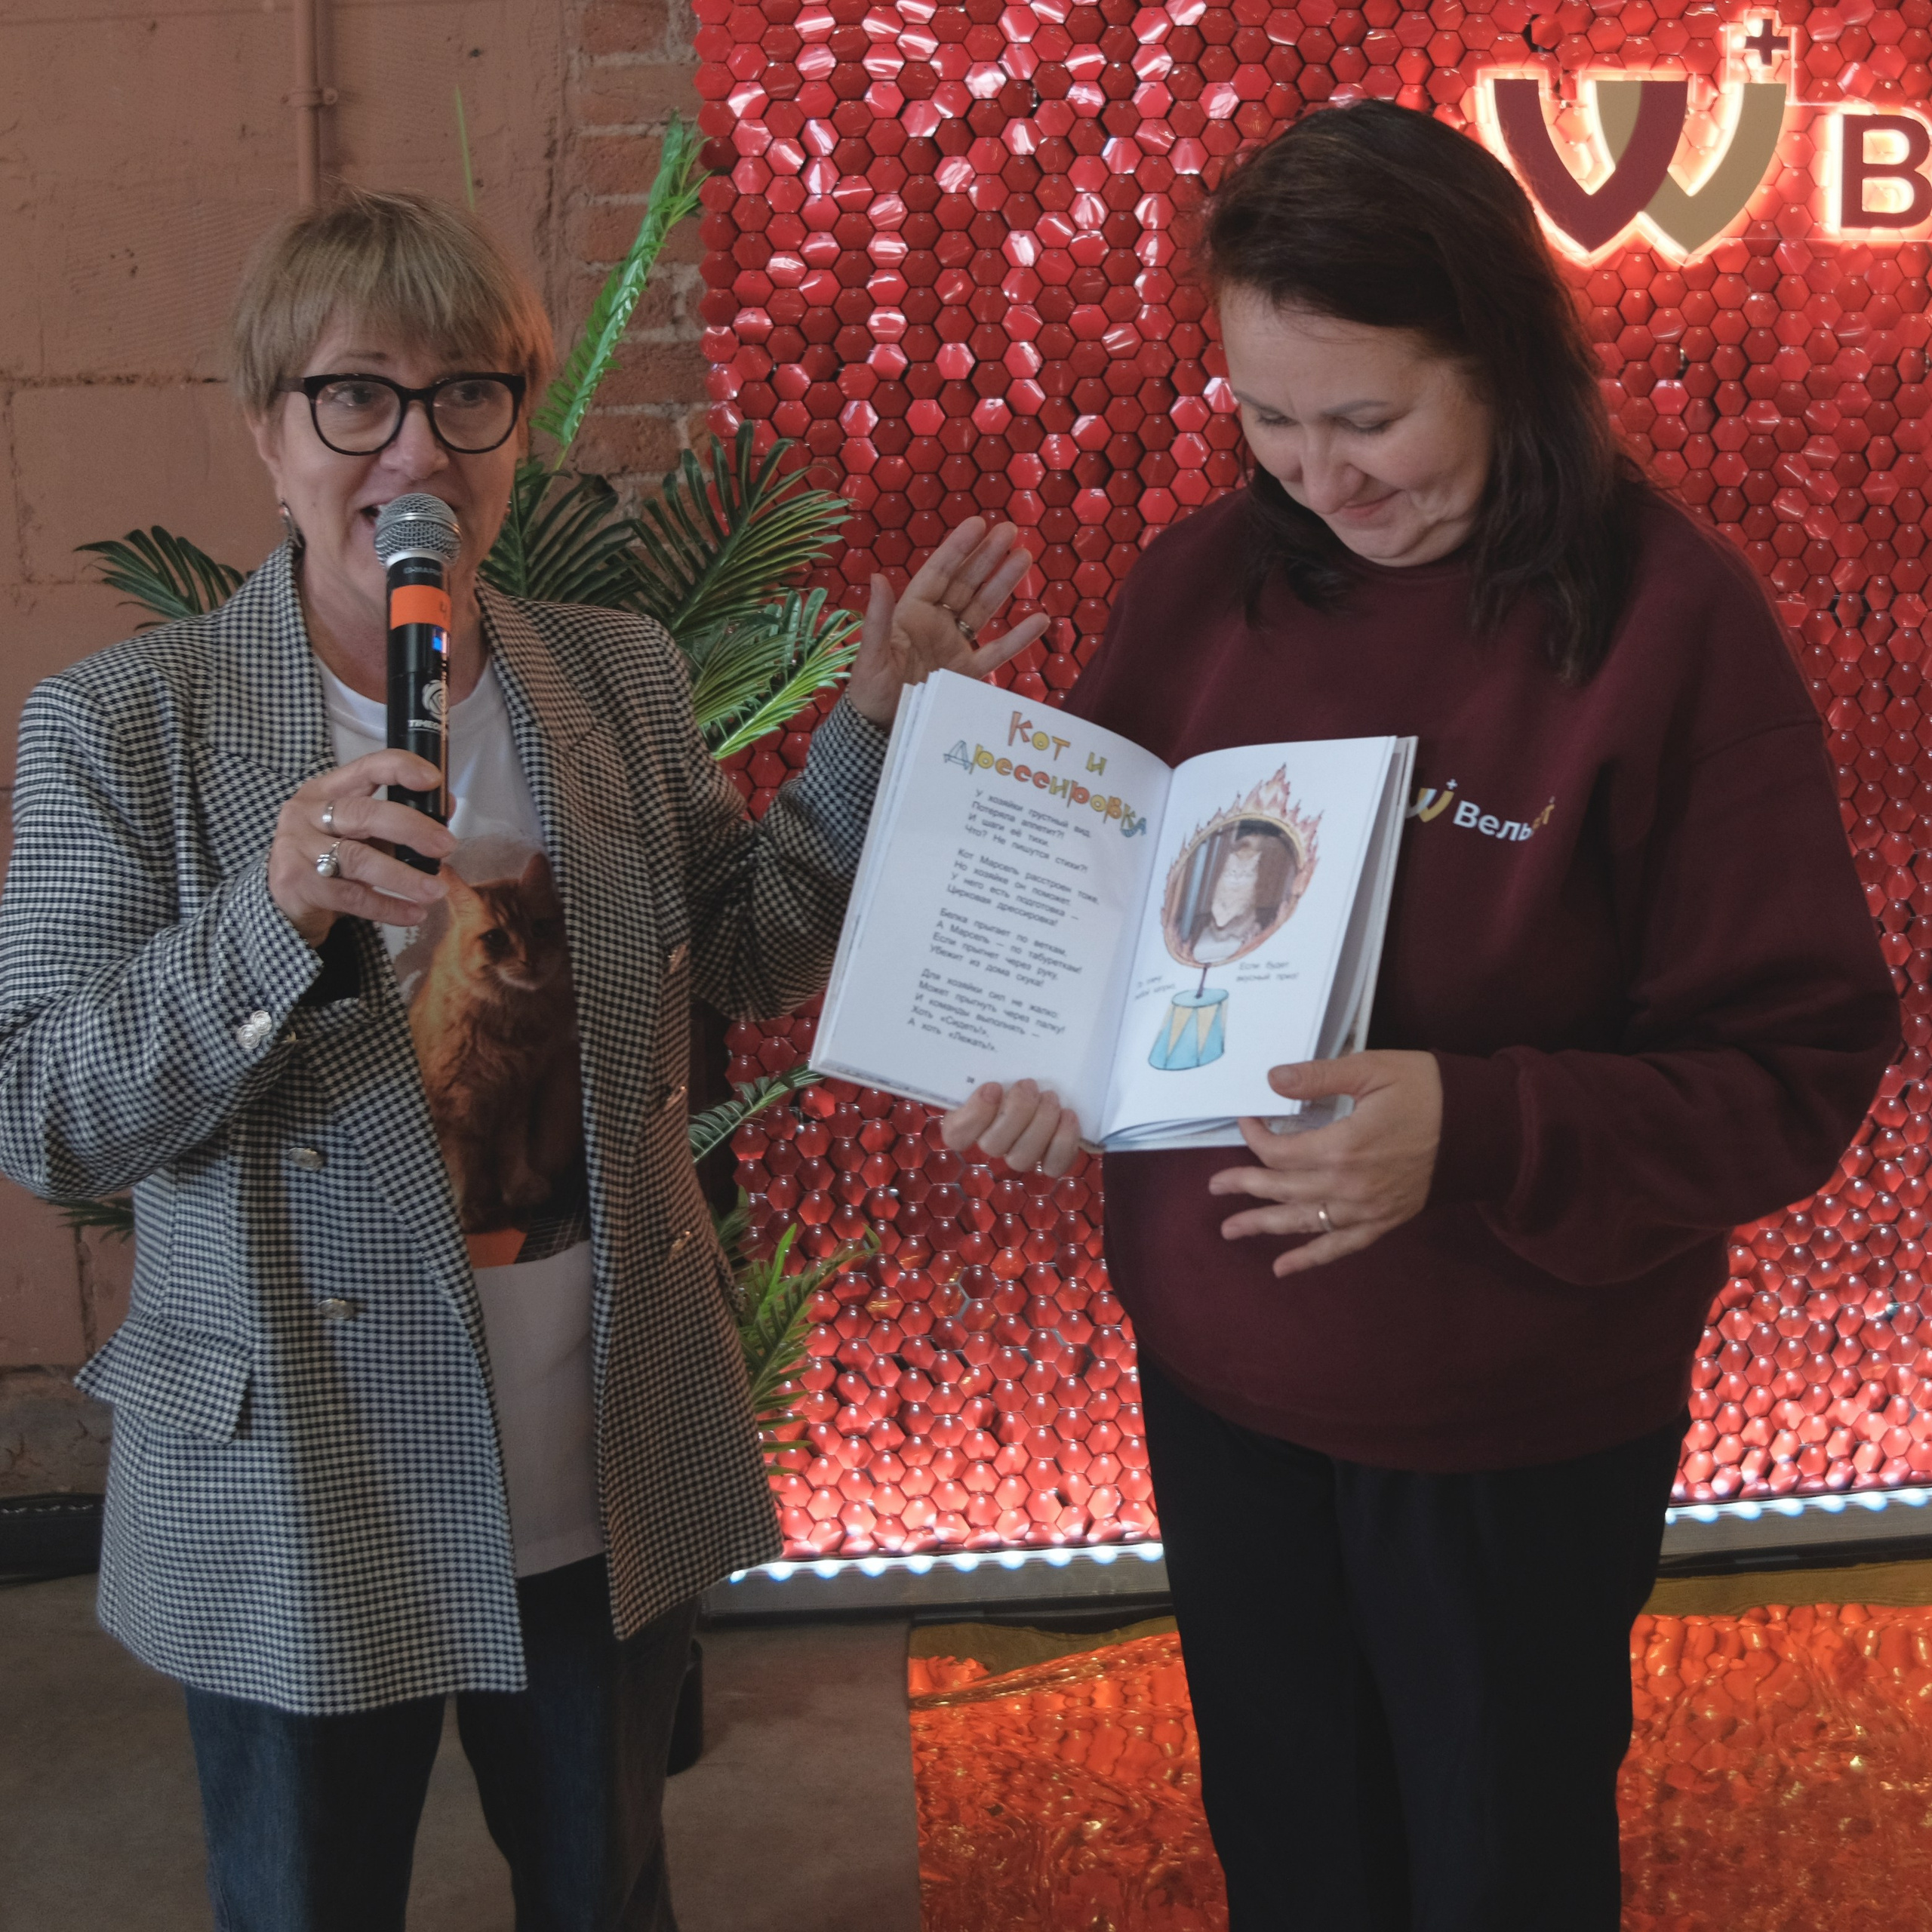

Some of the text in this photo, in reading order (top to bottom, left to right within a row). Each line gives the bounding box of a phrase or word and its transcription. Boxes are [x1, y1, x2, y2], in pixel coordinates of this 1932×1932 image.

[968, 813, 977, 821] И
[981, 819, 1004, 831] шаги
[971, 801, 1064, 838] Потеряла аппетит?!
[976, 789, 983, 797] У
[988, 795, 1023, 811] хозяйки
[1028, 809, 1069, 828] грустный
[964, 824, 1088, 871] Что? Не пишутся стихи?!
[954, 860, 968, 871] Но
[973, 868, 1008, 884] хозяйке
[1014, 881, 1026, 890] он
[958, 848, 974, 859] Кот
[980, 855, 1020, 875] Марсель
[1024, 872, 1072, 893] расстроен
[946, 884, 1058, 926] Цирковая дрессировка!
[963, 878, 983, 889] него
[989, 886, 1010, 898] есть
[1016, 895, 1065, 917] подготовка
[940, 907, 968, 924] Белка
[974, 921, 1011, 937] прыгает
[1016, 934, 1028, 943] по
[933, 931, 956, 945] Если
[962, 943, 999, 958] прыгнет
[1005, 957, 1032, 971] через
[936, 920, 943, 929] А
[949, 924, 990, 944] Марсель
[1011, 946, 1022, 954] по
[1029, 951, 1082, 974] табуреткам!
[921, 968, 941, 980] Для
[946, 978, 983, 994] хозяйки
[989, 991, 1005, 1001] сил
[985, 964, 1010, 977] дома
[1016, 974, 1044, 986] скука!
[911, 1005, 933, 1019] Хоть
[918, 980, 1065, 1034] Может прыгнуть через палку!
[928, 999, 970, 1017] команды
[907, 1017, 915, 1026] А
[921, 1023, 941, 1035] хоть
